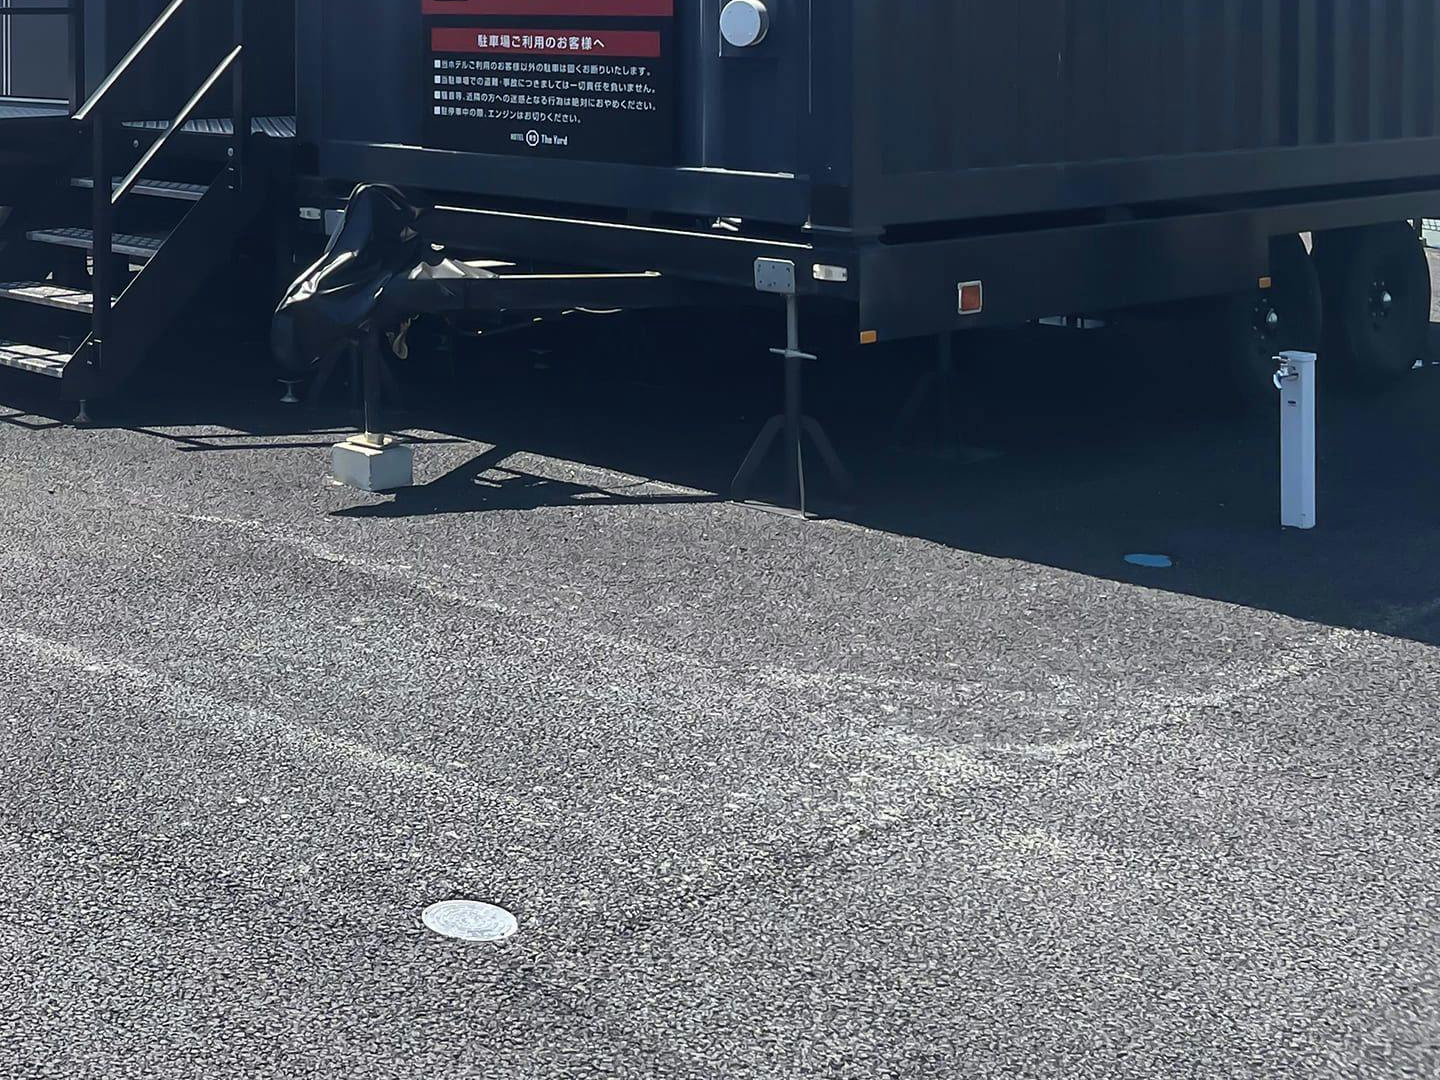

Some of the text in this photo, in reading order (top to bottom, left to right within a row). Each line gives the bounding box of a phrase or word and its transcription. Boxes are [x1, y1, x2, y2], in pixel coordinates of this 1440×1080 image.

[477, 34, 605, 50] 駐車場ご利用のお客様へ
